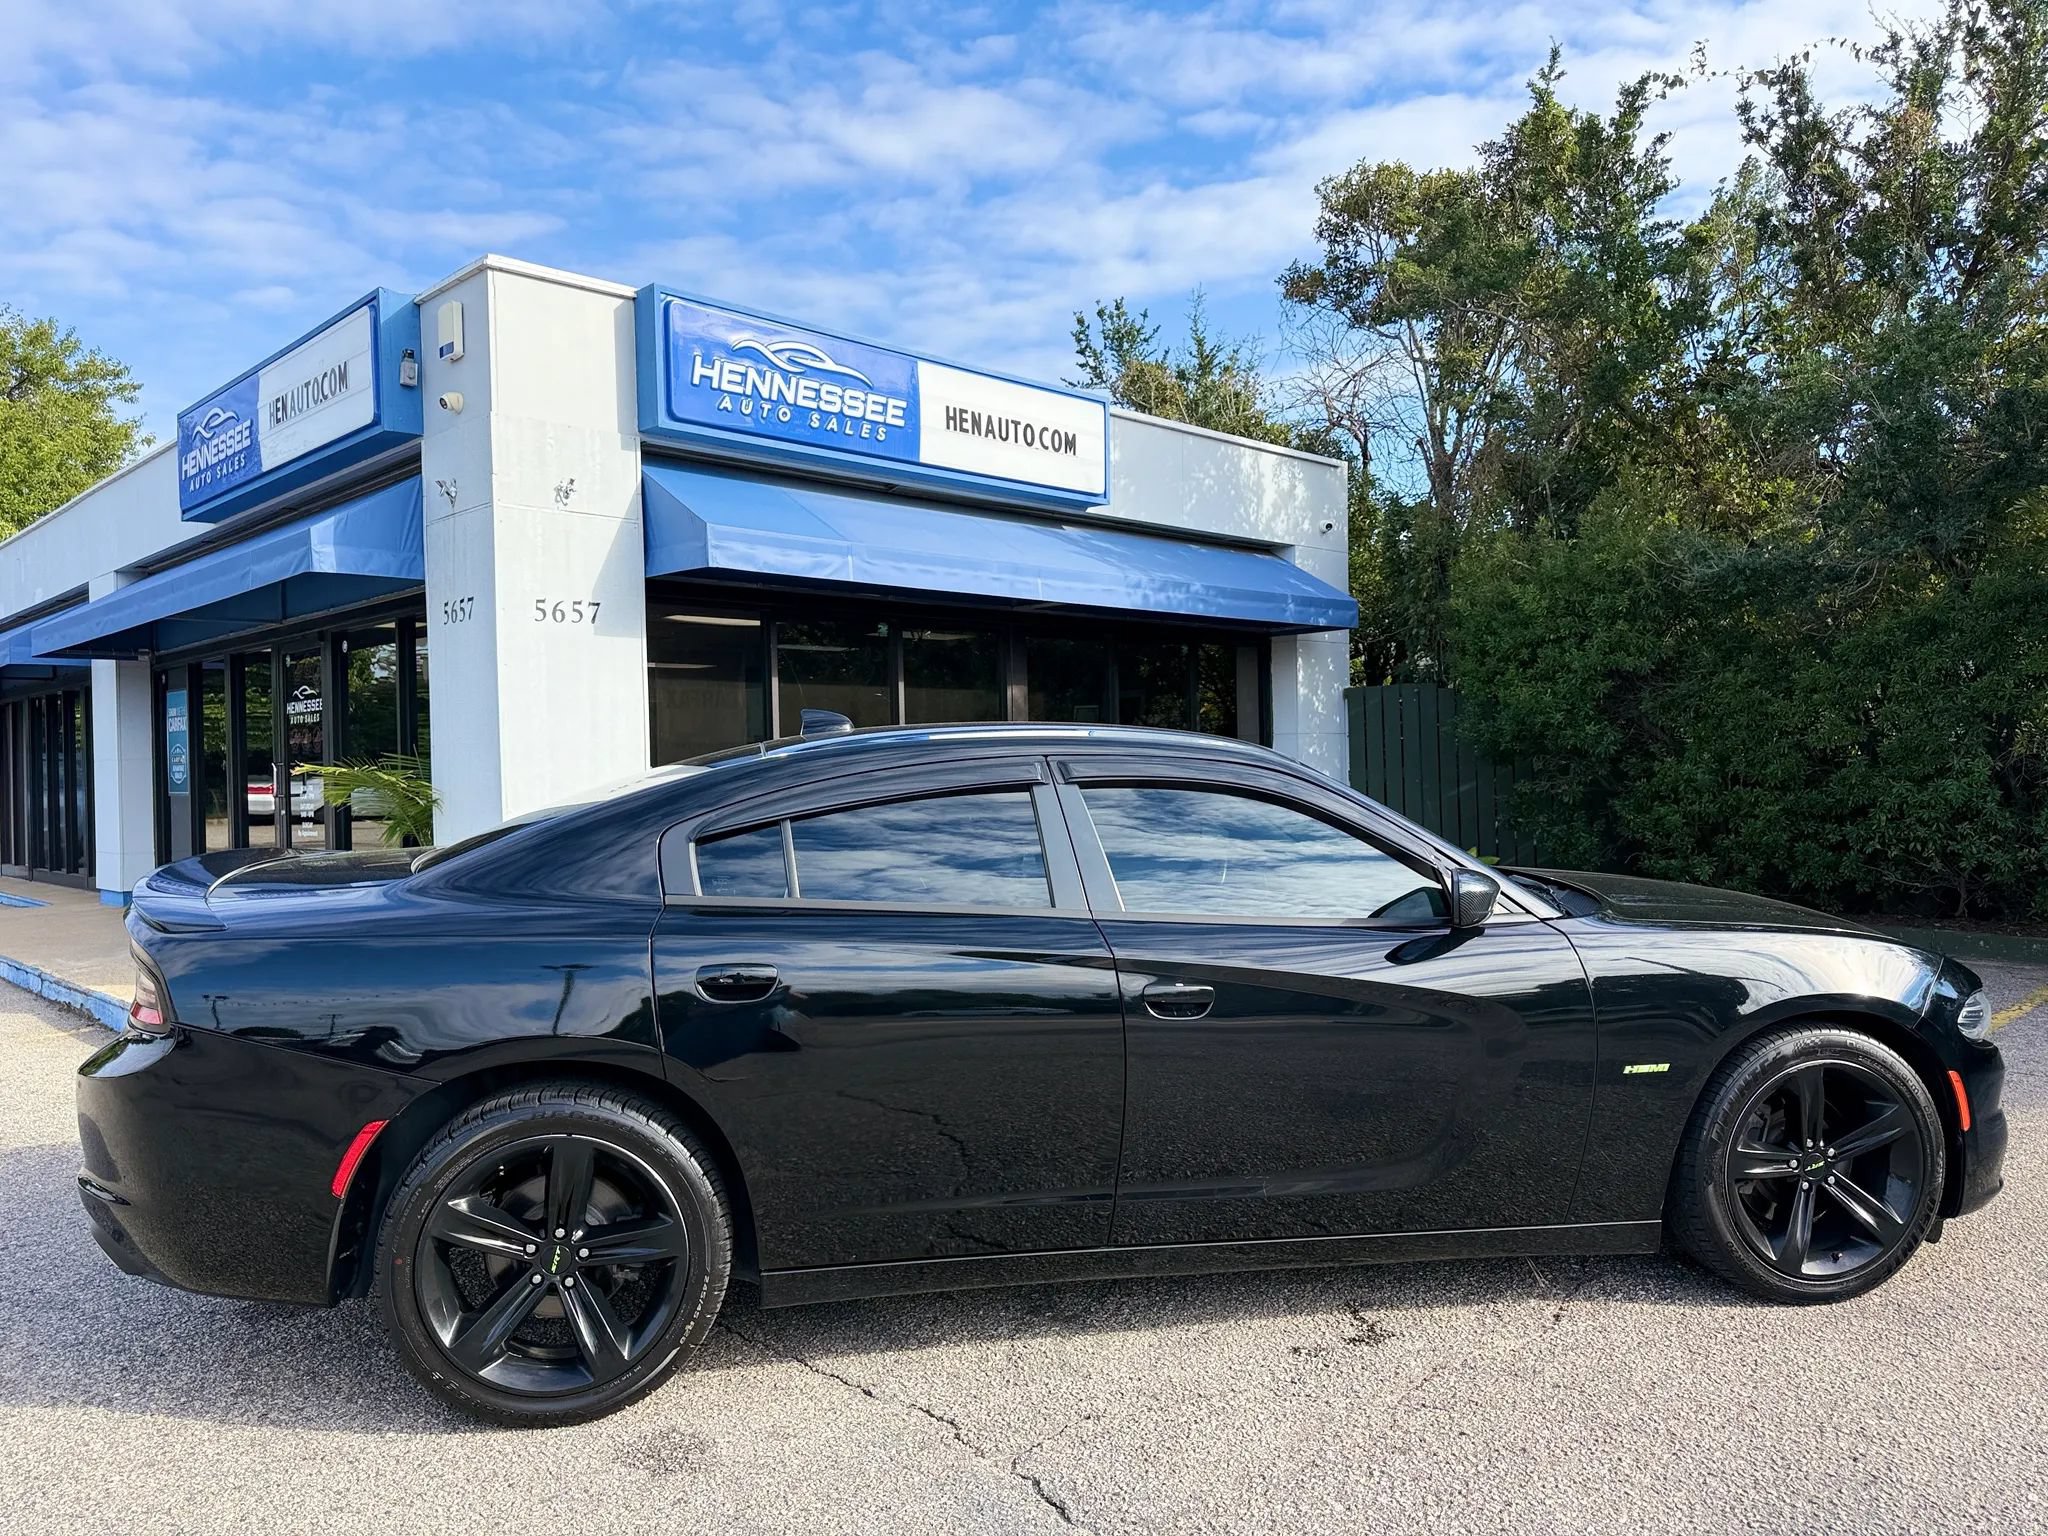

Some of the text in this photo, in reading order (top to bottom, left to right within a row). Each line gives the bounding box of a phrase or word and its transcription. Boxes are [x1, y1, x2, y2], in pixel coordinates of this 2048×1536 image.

[269, 361, 348, 430] HENAUTO.COM
[691, 353, 908, 427] HENNESSEE
[718, 393, 887, 442] AUTO SALES
[181, 419, 252, 481] HENNESSEE
[189, 454, 246, 493] AUTO SALES
[443, 596, 475, 625] 5657
[534, 598, 601, 625] 5657
[286, 698, 323, 714] HENNESSEE
[290, 713, 320, 724] AUTO SALES
[1622, 1063, 1671, 1074] HEMI
